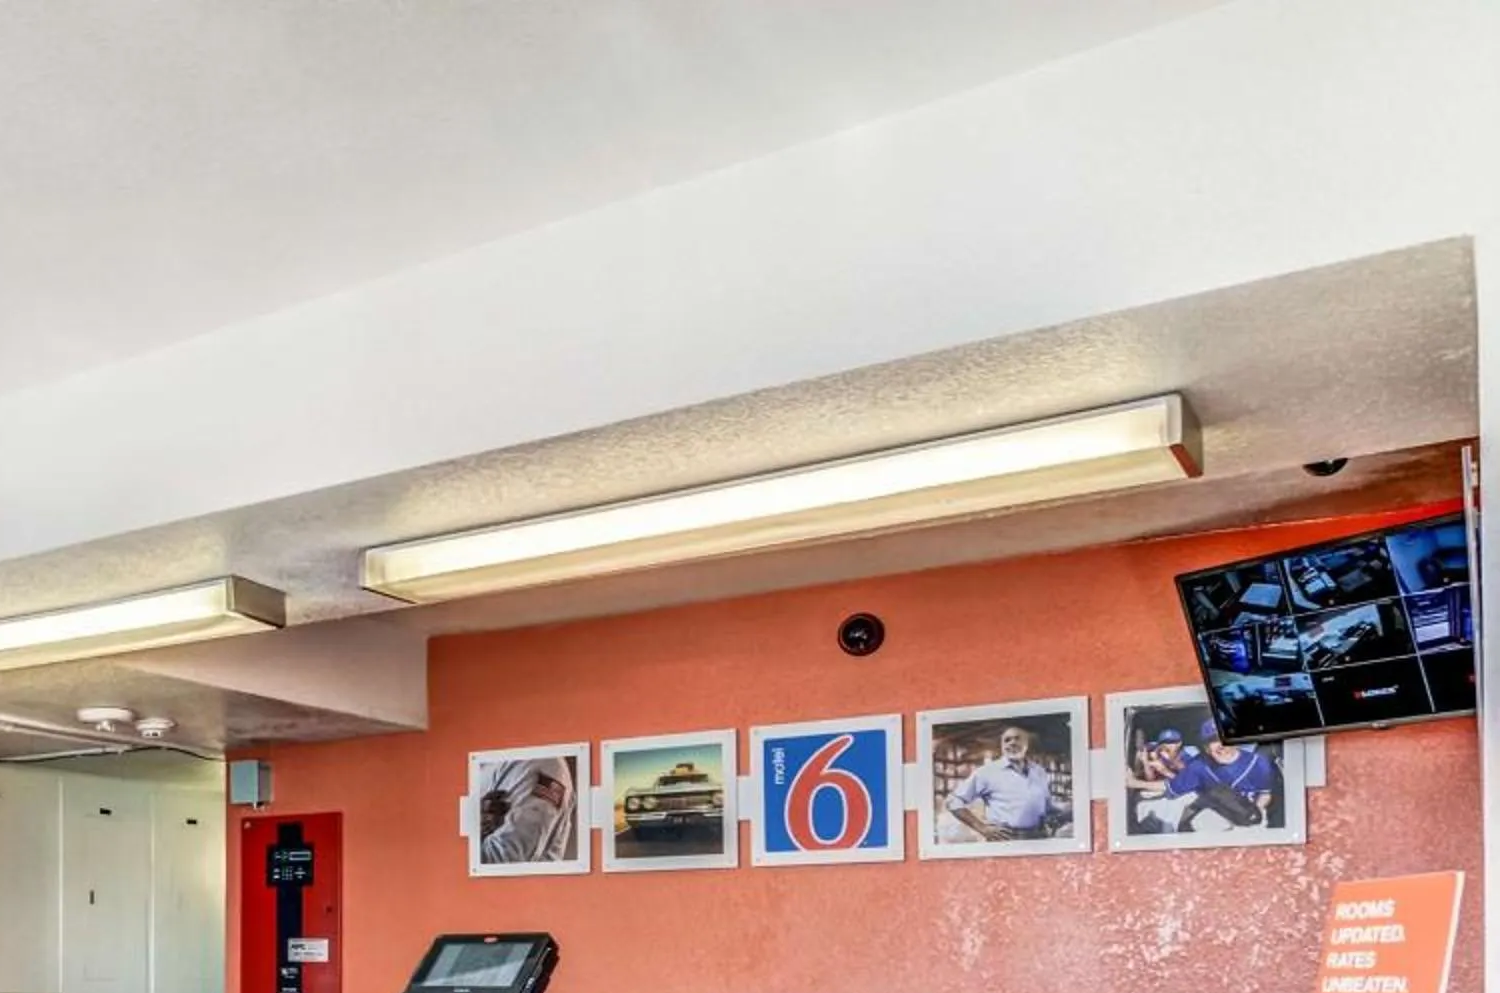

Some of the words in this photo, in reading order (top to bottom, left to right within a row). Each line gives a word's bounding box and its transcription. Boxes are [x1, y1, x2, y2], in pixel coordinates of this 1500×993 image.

[772, 747, 785, 785] motel
[784, 734, 872, 851] 6
[1335, 898, 1396, 920] ROOMS
[1326, 951, 1377, 968] RATES
